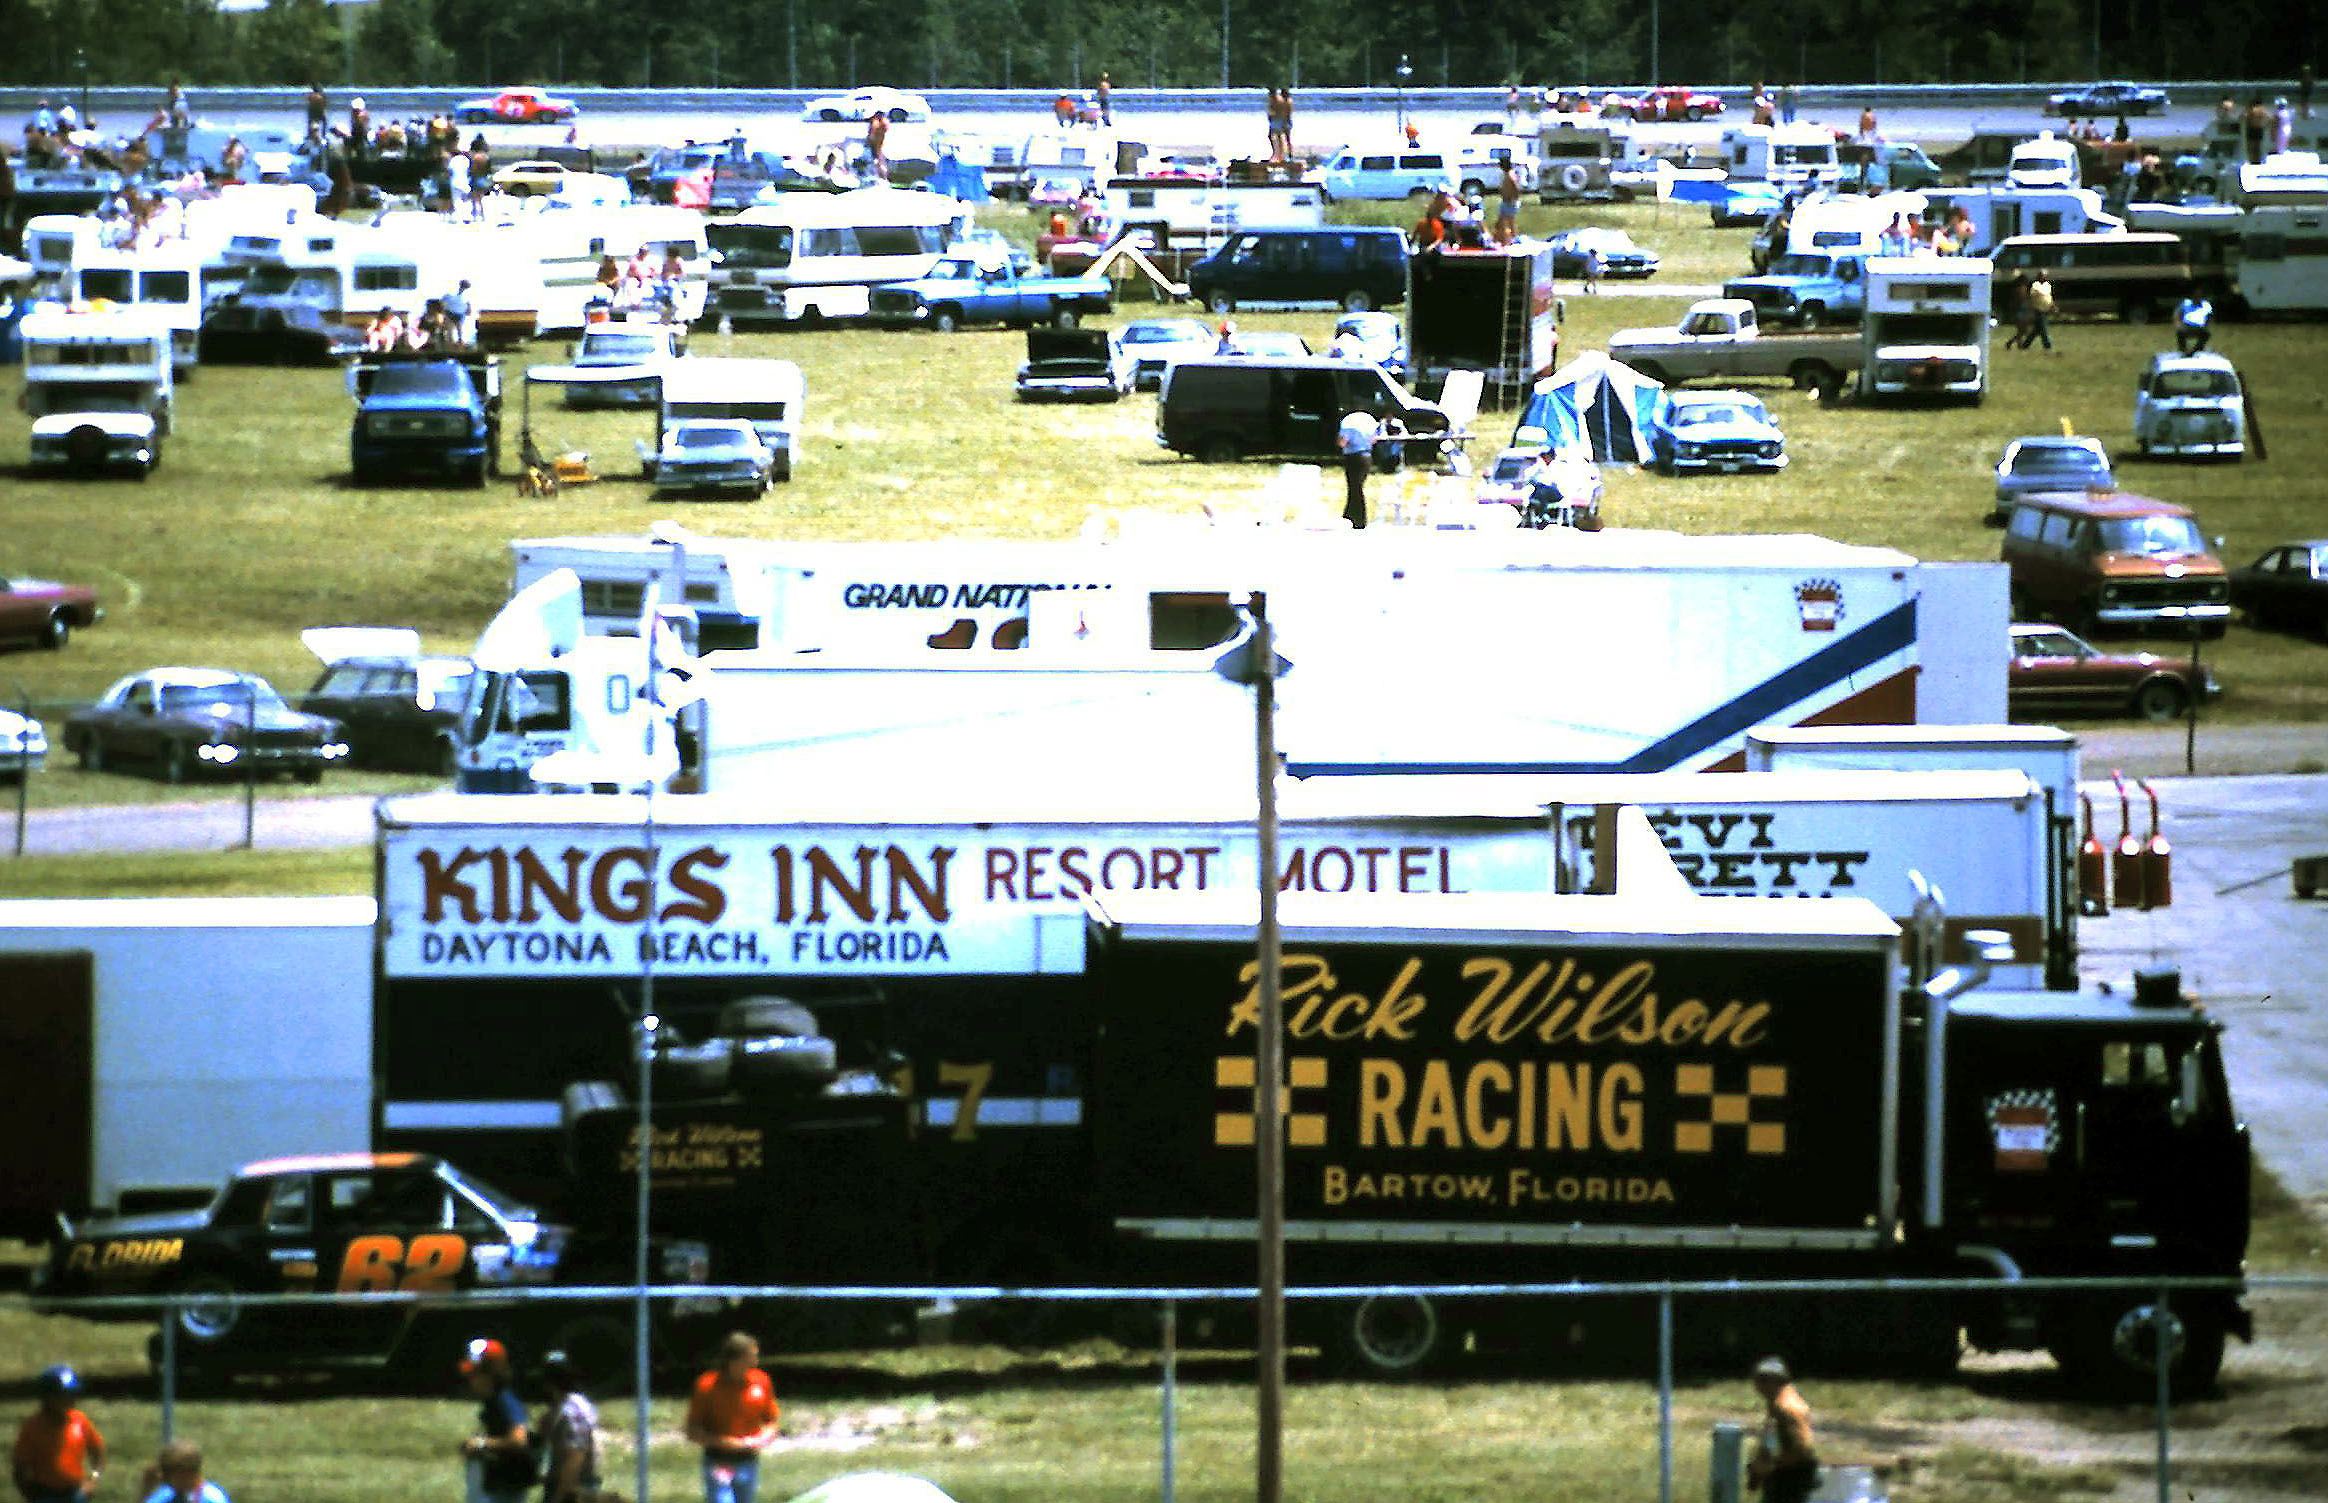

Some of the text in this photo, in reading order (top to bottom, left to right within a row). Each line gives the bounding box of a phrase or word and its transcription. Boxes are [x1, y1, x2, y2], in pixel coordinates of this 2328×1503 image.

[844, 584, 949, 608] GRAND
[417, 846, 730, 925] KINGS
[771, 844, 957, 925] INN
[985, 847, 1221, 900] RESORT
[423, 931, 951, 965] DAYTONA BEACH, FLORIDA
[1226, 953, 1772, 1047] Rick Wilson
[1359, 1058, 1646, 1151] RACING
[1324, 1165, 1676, 1207] BARTOW, FLORIDA
